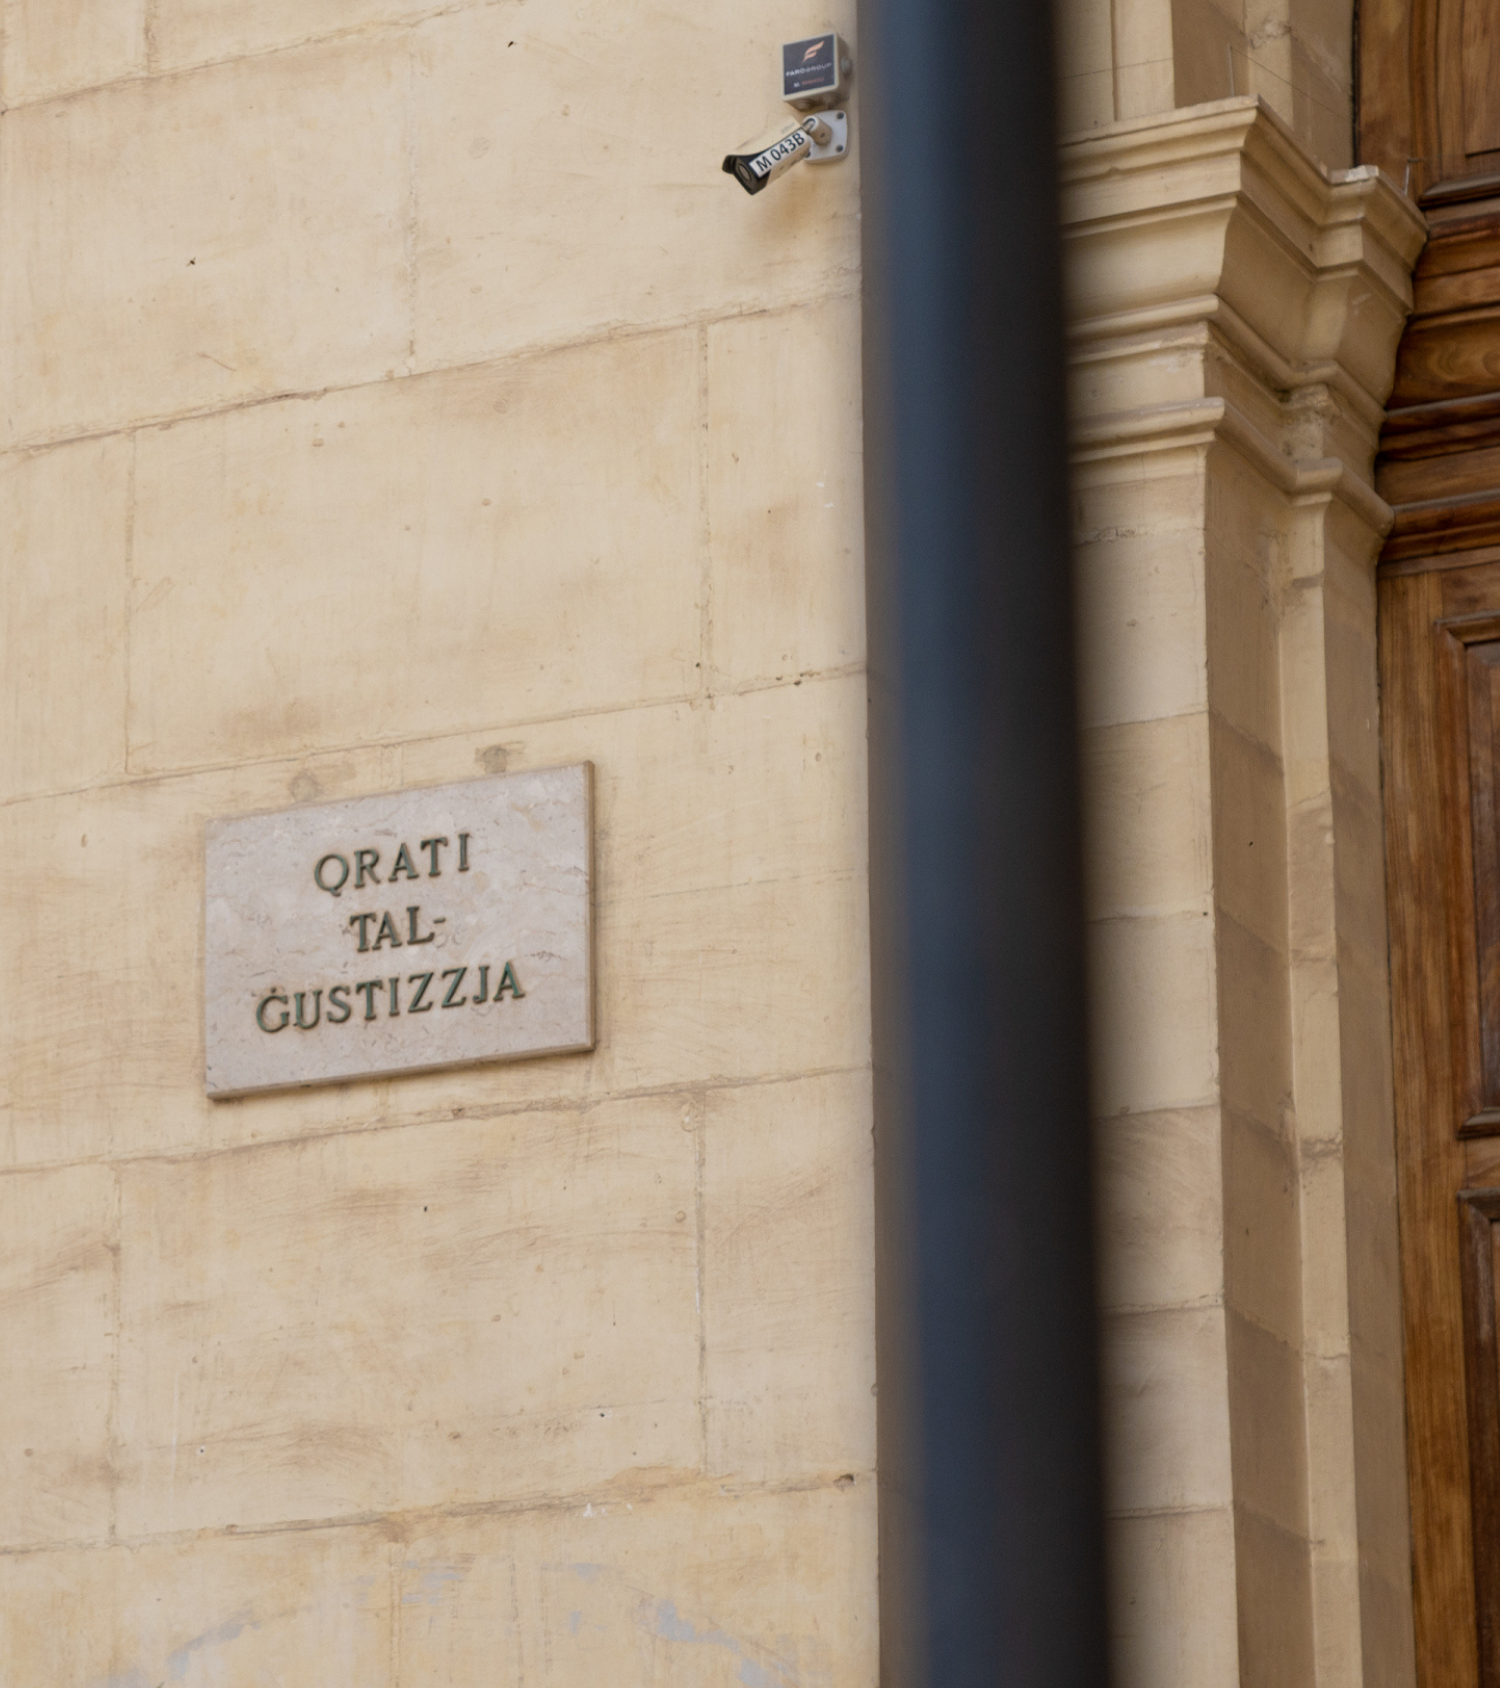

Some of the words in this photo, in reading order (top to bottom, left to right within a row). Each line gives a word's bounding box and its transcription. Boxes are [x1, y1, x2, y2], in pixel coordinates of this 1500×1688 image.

[756, 156, 772, 172] M
[770, 132, 805, 161] 043B
[314, 833, 471, 896] QRATI
[349, 906, 446, 952] TAL-
[256, 961, 525, 1034] ĠUSTIZZJA
